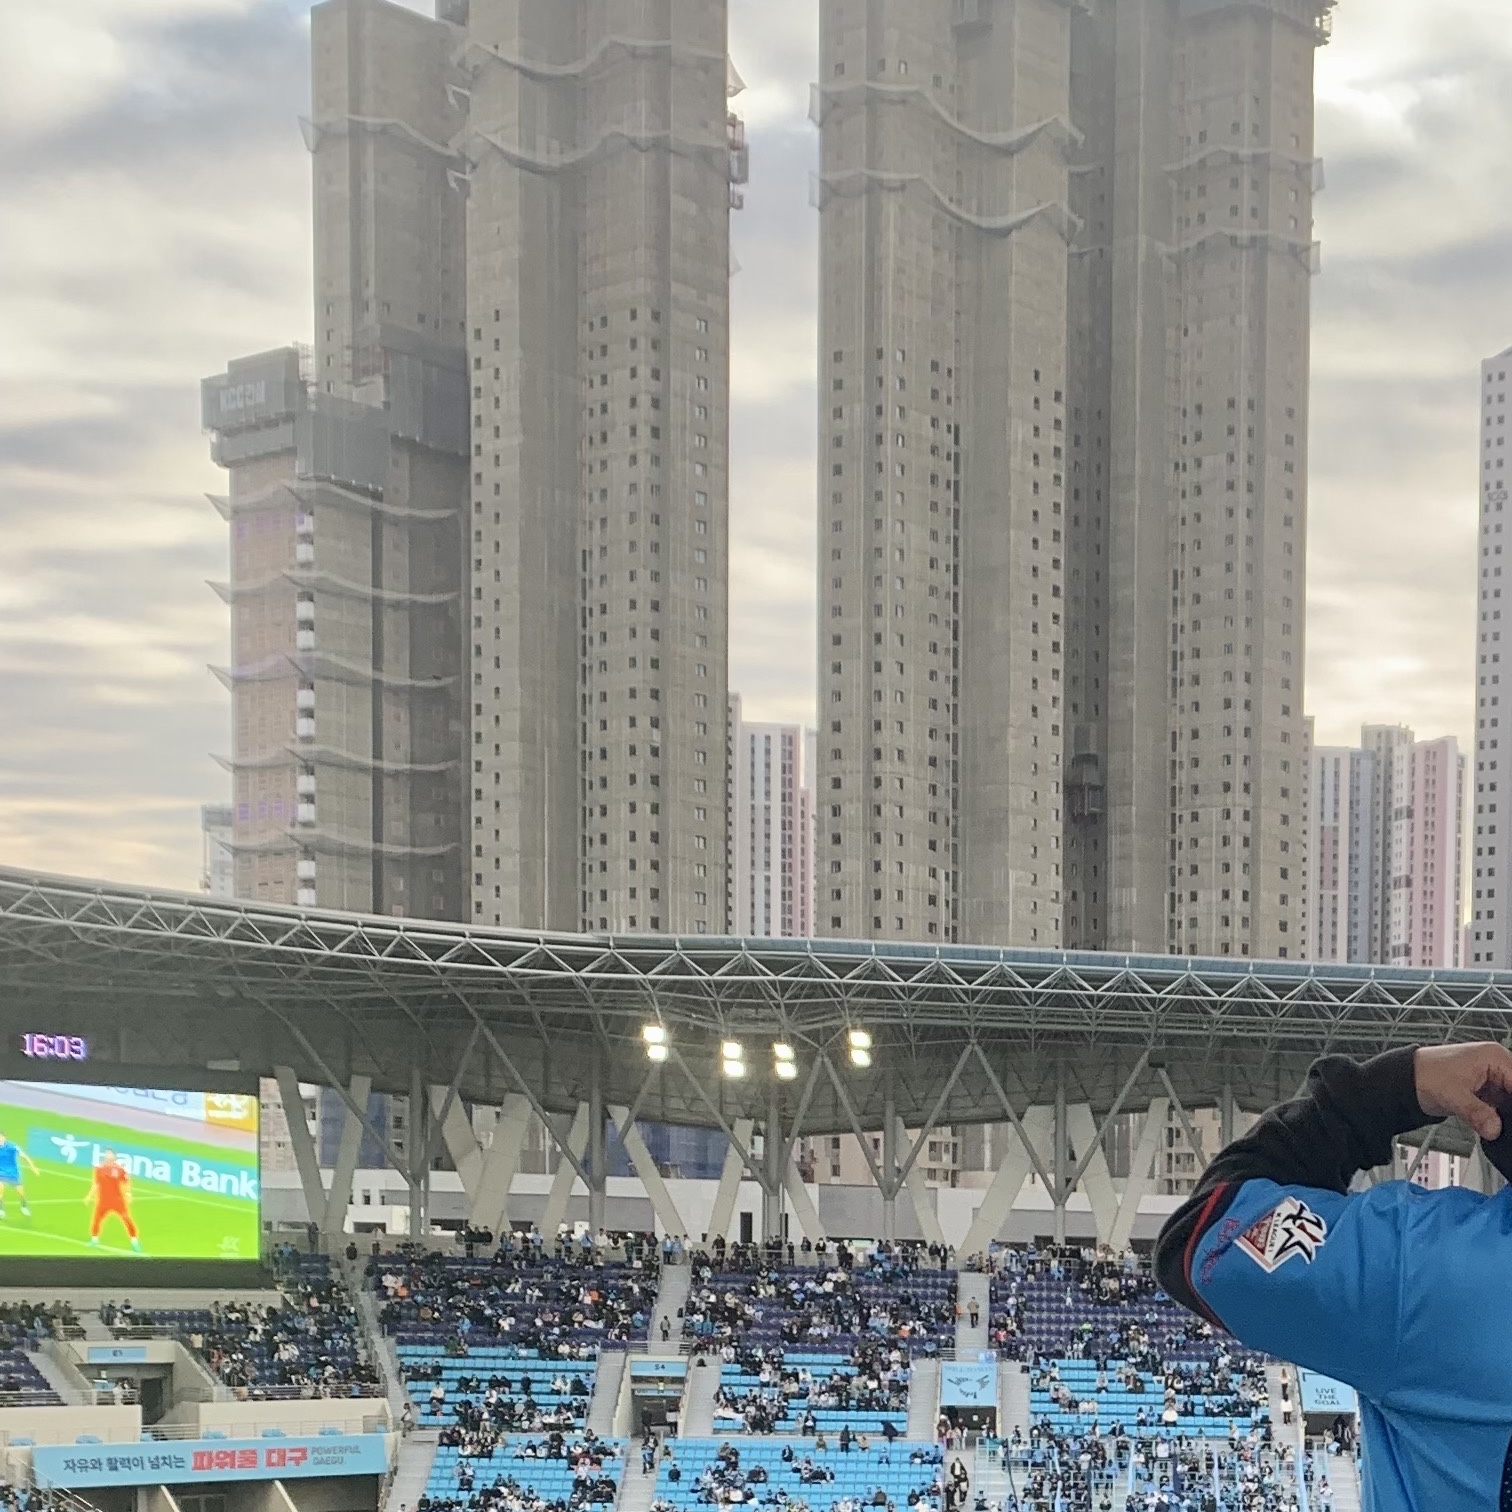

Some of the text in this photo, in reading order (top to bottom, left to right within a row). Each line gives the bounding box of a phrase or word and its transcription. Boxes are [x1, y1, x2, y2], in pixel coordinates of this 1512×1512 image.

[20, 1032, 87, 1061] 16:03
[181, 1159, 259, 1200] Bank
[63, 1446, 308, 1473] 자유와 활력이 넘치는 파워풀 대구
